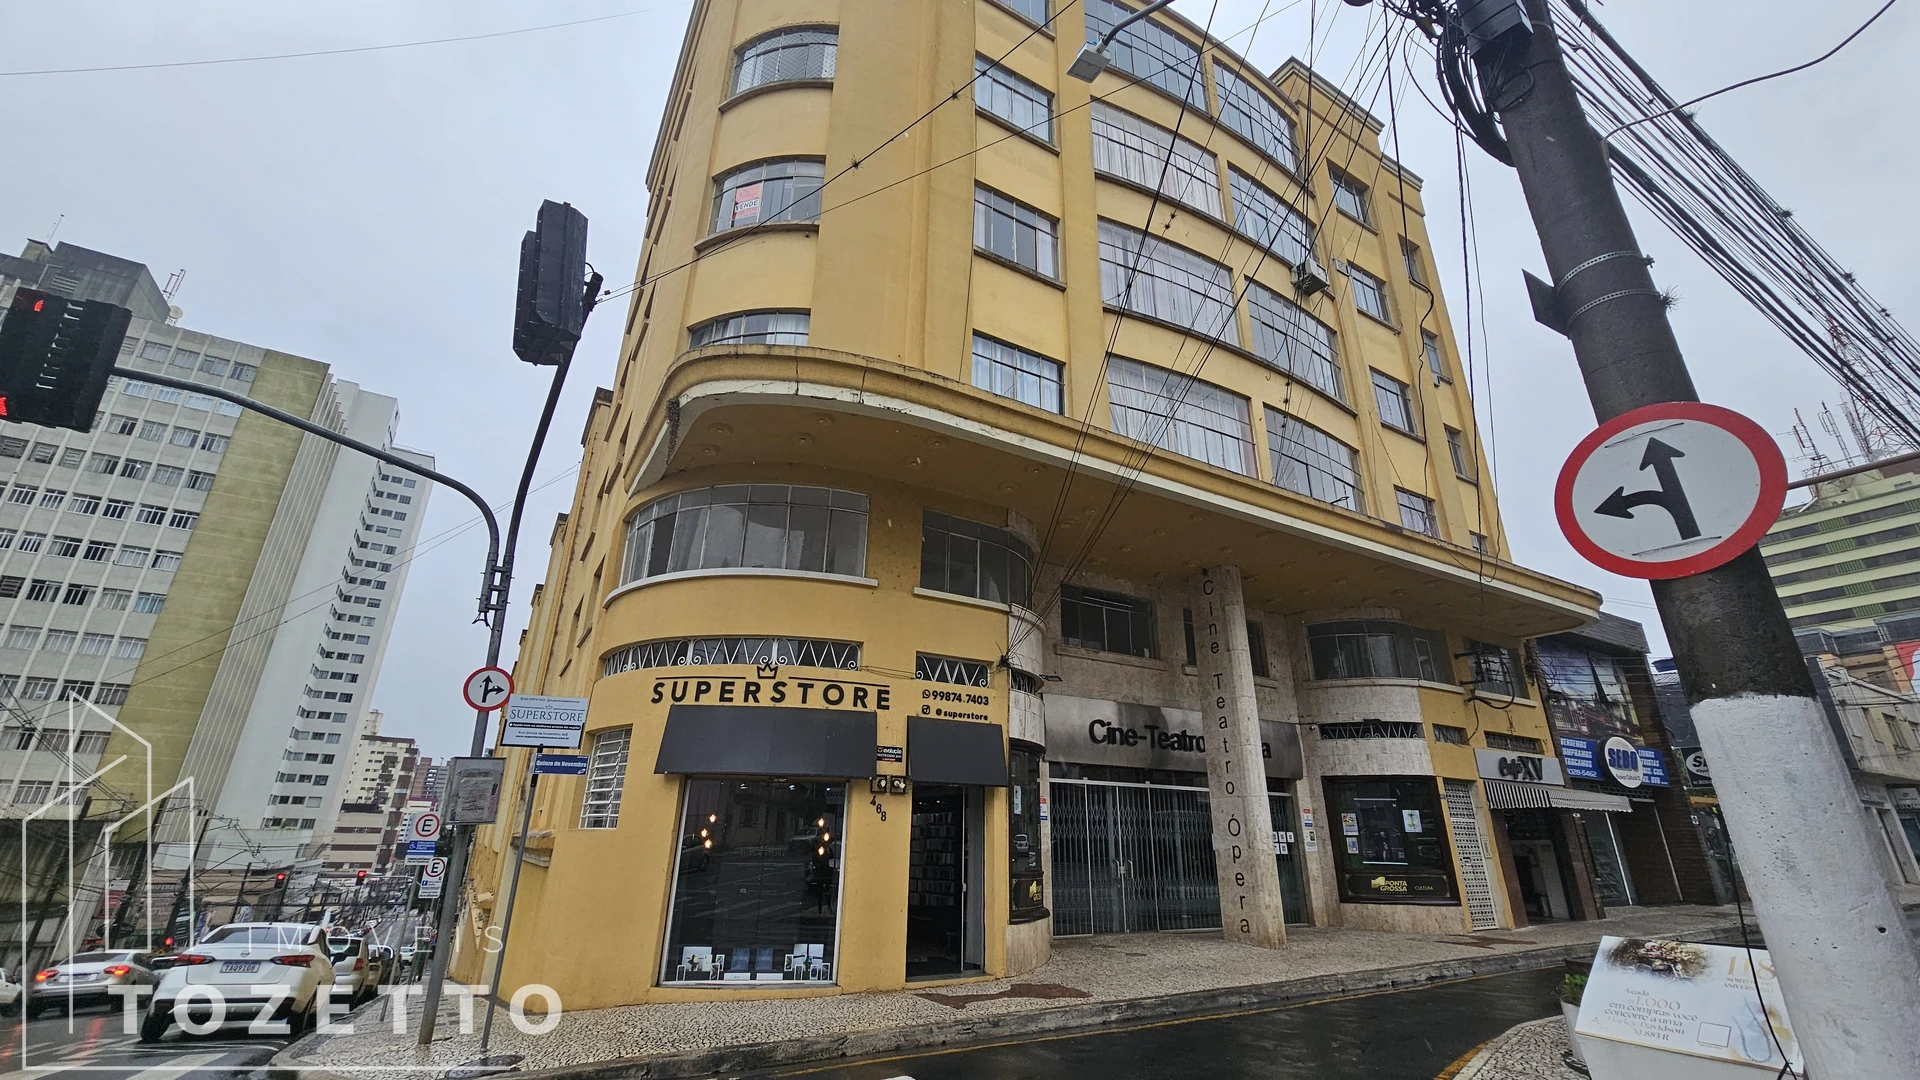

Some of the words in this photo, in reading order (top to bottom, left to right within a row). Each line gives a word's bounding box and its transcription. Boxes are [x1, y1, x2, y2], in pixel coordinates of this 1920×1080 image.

[735, 200, 759, 211] VENDE
[651, 681, 890, 710] SUPERSTORE
[932, 690, 989, 706] 99874.7403
[509, 709, 584, 722] SUPERSTORE
[1089, 719, 1206, 753] Cine-Teatro
[1203, 579, 1220, 654] Cine
[1213, 673, 1235, 794] Teatro
[1228, 813, 1250, 934] Ópera
[1562, 748, 1592, 758] OMPRAMOS
[1608, 748, 1638, 771] SEBO
[1517, 756, 1543, 780] XV
[870, 795, 886, 821] 468
[421, 819, 433, 832] E
[431, 862, 440, 873] E
[1604, 1008, 1649, 1021] concorre
[1658, 1018, 1682, 1027] uma
[1609, 1002, 1625, 1010] em
[1627, 1005, 1670, 1017] compras
[1673, 1013, 1698, 1022] você
